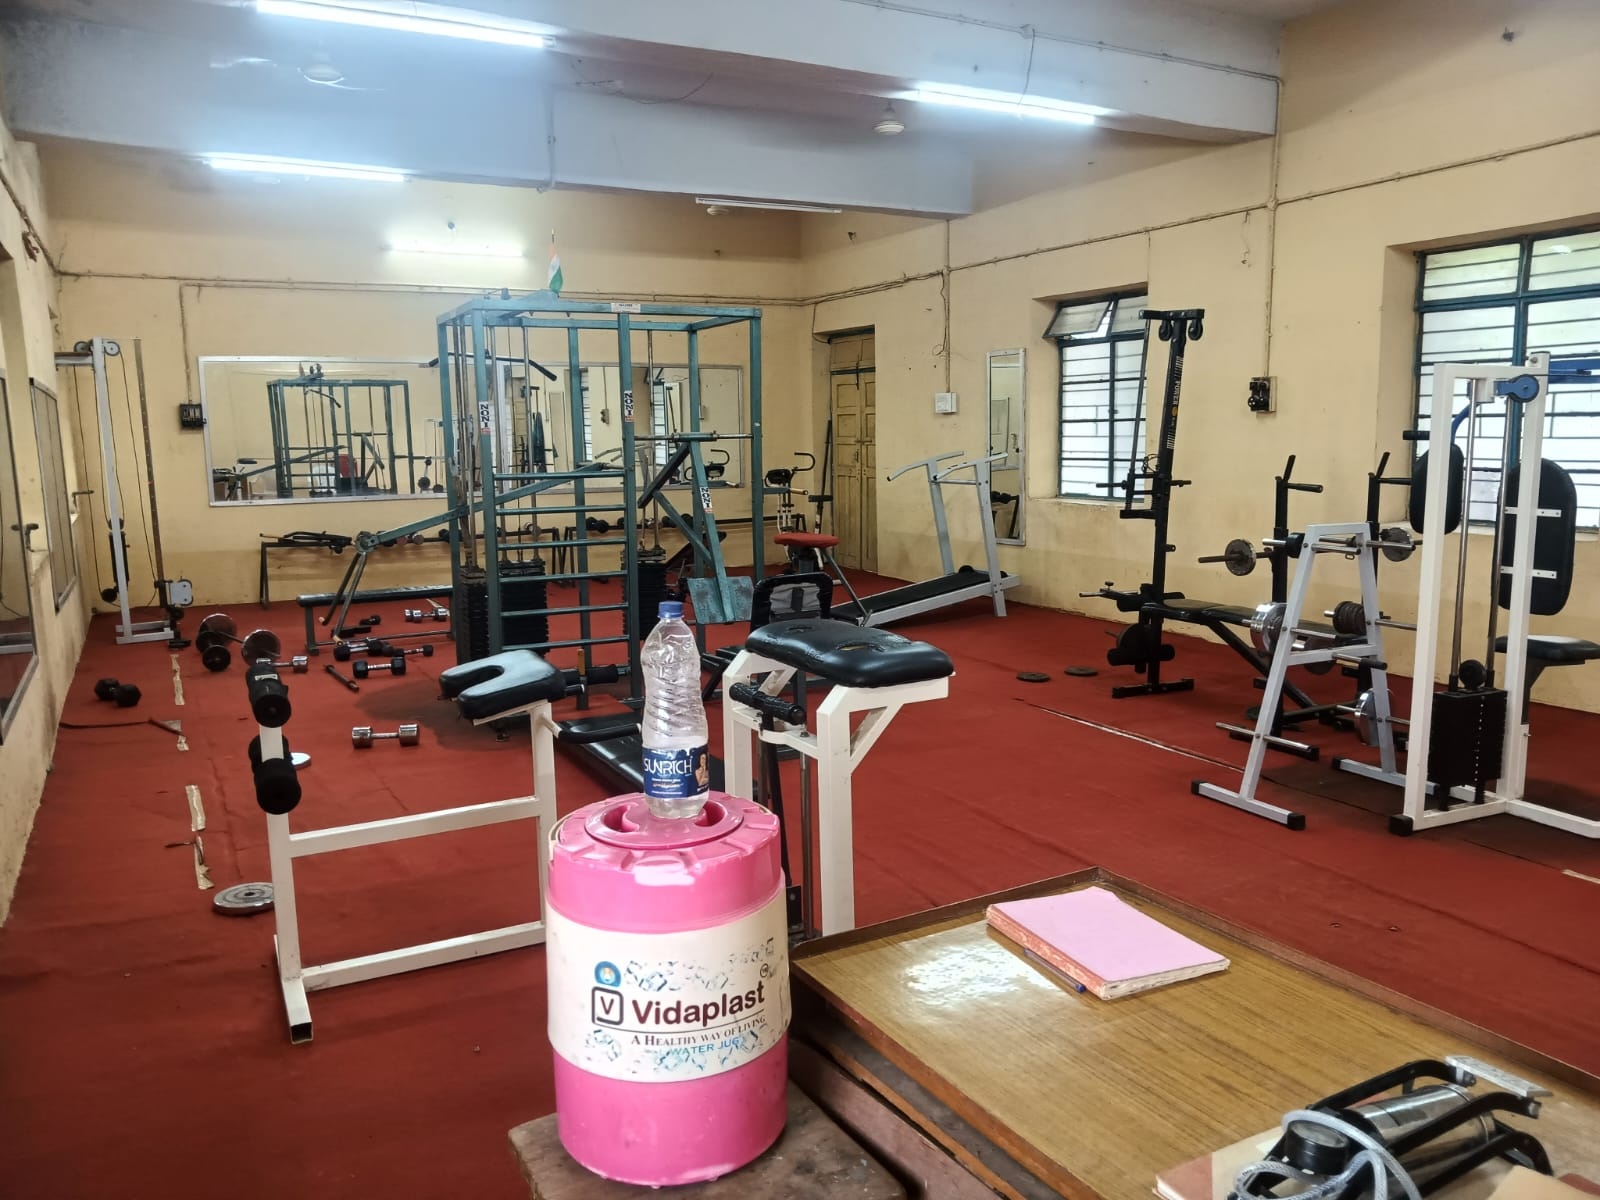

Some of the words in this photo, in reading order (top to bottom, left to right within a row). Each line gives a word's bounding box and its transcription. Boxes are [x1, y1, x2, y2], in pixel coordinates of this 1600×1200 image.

[480, 403, 491, 428] NONI
[624, 392, 634, 416] NONI
[700, 487, 711, 508] NONI
[643, 758, 692, 775] SUNRICH
[632, 980, 766, 1027] Vidaplast
[631, 1035, 641, 1045] A
[645, 1035, 697, 1046] HEALTHY
[700, 1032, 720, 1042] WAY
[724, 1027, 737, 1037] OF
[738, 1016, 766, 1032] LIVING
[669, 1043, 715, 1056] WATER
[717, 1037, 740, 1049] JUG
